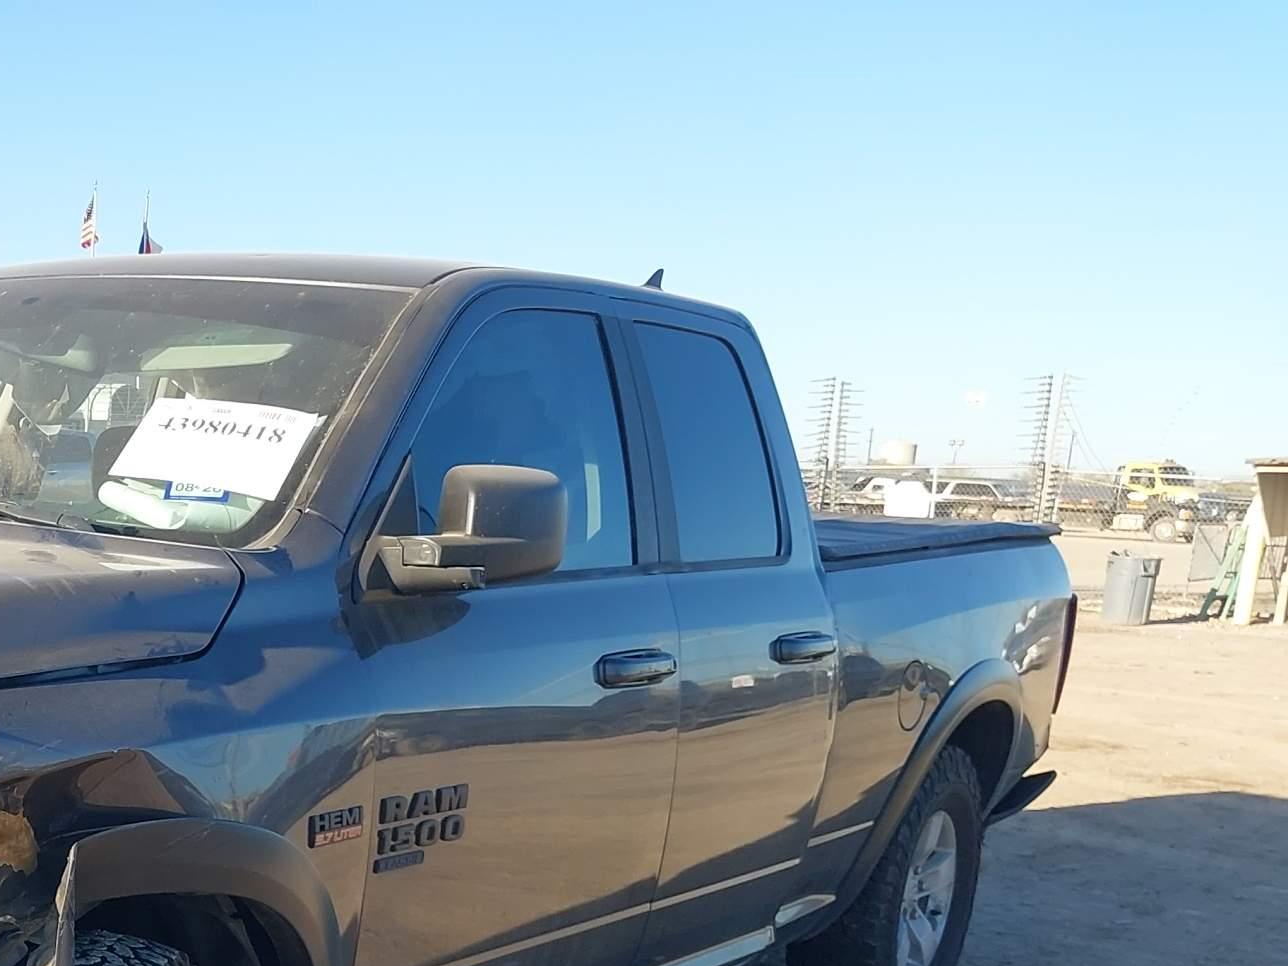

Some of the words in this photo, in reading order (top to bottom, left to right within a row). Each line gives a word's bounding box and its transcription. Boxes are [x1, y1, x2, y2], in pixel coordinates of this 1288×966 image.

[158, 416, 286, 444] 43980418
[380, 783, 469, 824] RAM
[377, 814, 465, 855] 1500
